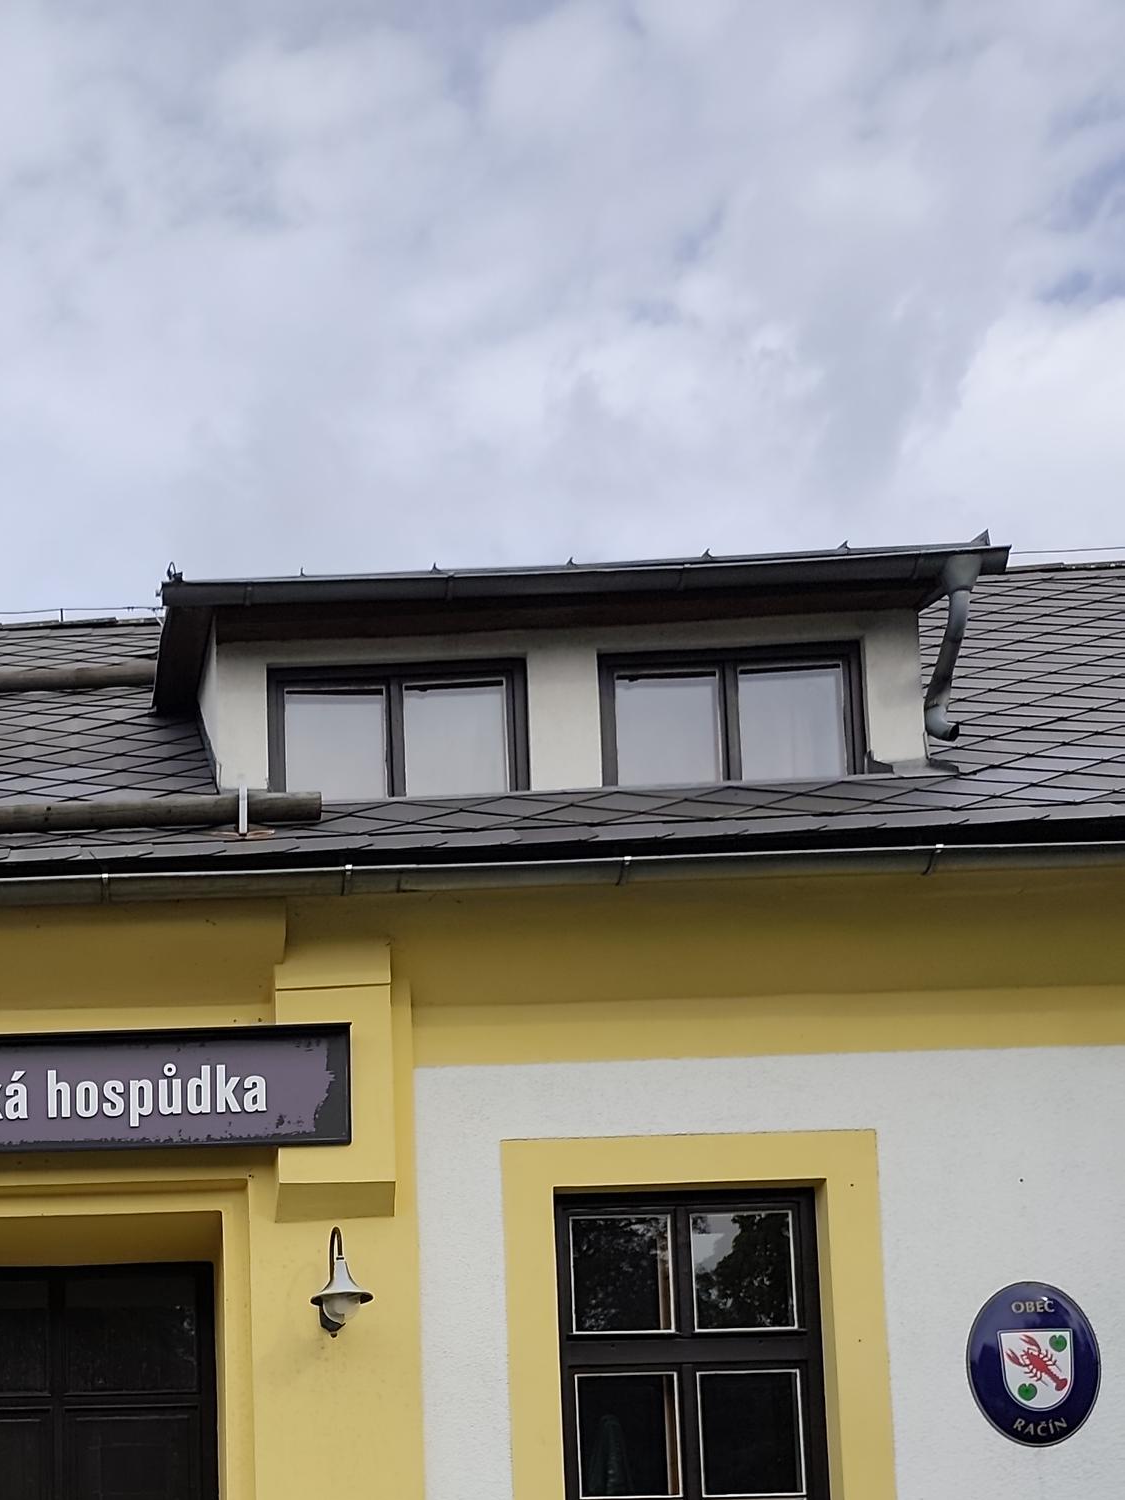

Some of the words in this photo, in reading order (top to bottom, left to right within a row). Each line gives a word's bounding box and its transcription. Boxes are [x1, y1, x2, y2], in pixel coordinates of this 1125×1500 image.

[46, 1062, 269, 1128] hospůdka
[1011, 1300, 1055, 1314] OBEC
[1012, 1417, 1068, 1436] RAČÍN
